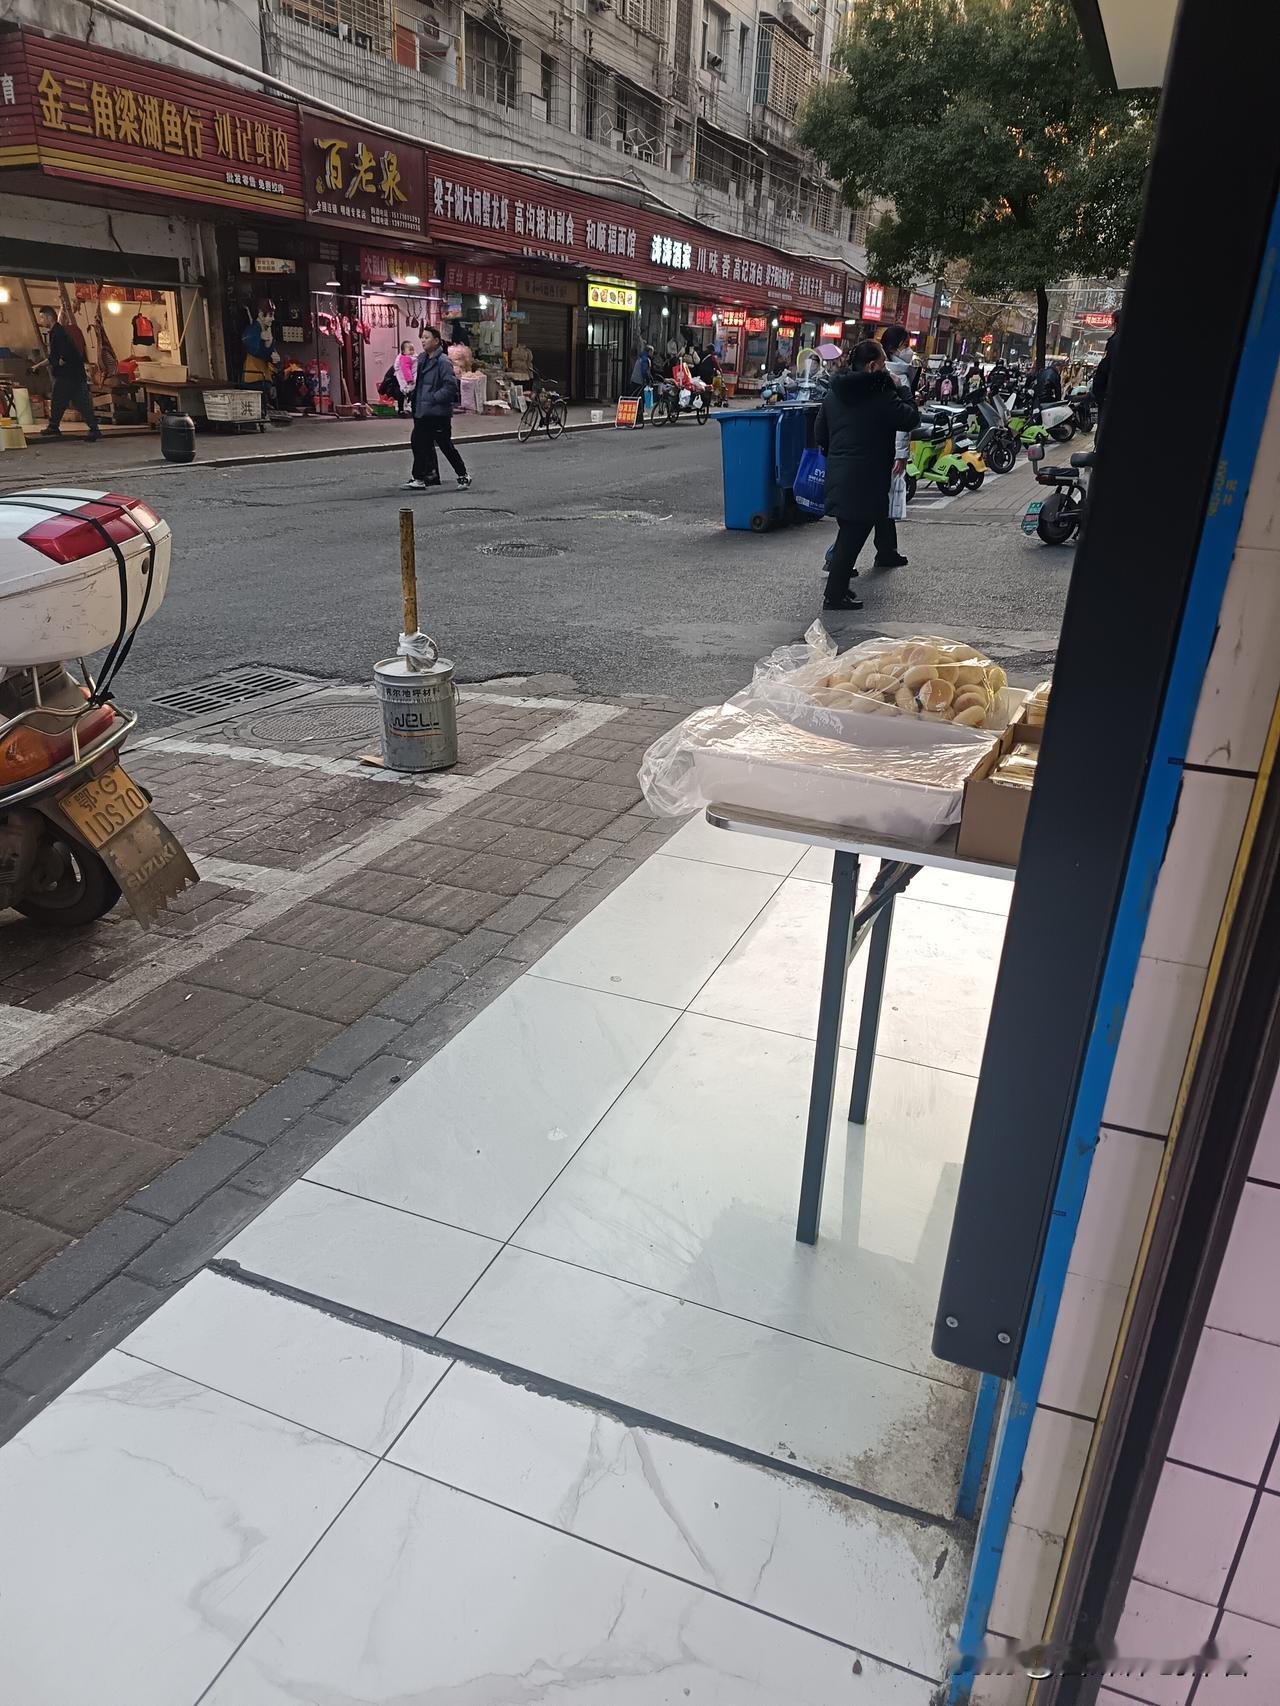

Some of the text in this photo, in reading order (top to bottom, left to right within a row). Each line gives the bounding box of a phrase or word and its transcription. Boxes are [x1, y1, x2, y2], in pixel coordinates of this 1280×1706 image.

[37, 69, 290, 171] 金三角梁湖鱼行 刘记鲜肉
[313, 137, 408, 207] 百老泉
[433, 176, 509, 232] 梁子湖大闸蟹龙虾
